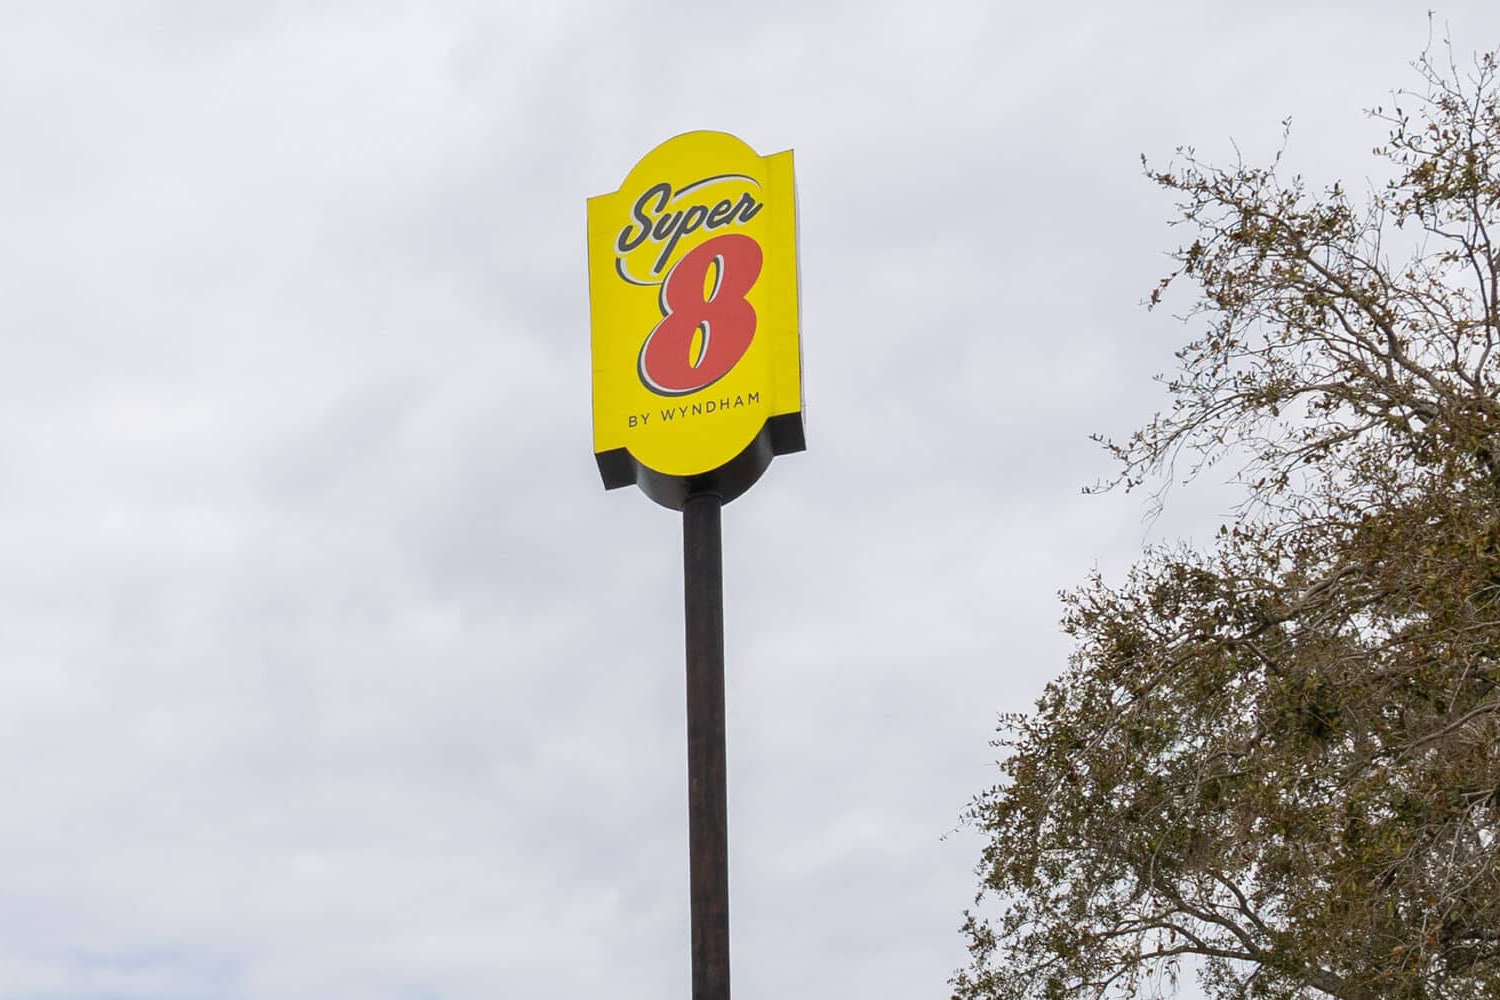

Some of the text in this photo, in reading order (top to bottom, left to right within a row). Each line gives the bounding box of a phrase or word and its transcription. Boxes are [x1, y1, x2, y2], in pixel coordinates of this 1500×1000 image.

[617, 182, 764, 274] Super
[638, 233, 763, 397] 8
[628, 391, 760, 428] BY WYNDHAM
